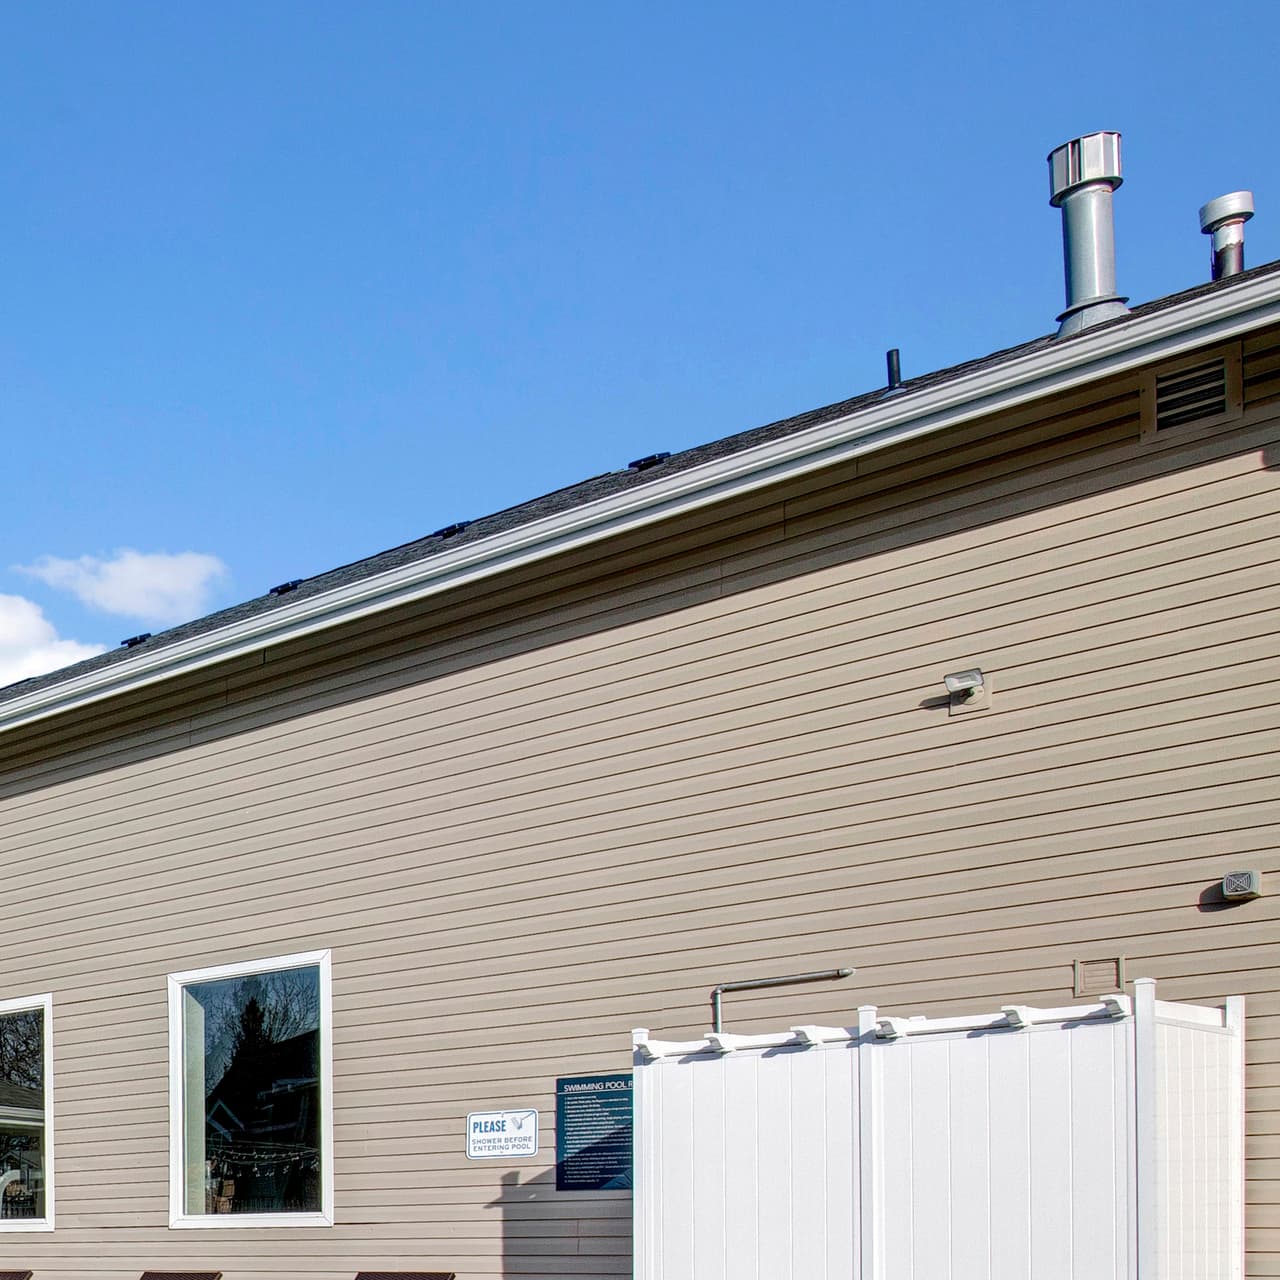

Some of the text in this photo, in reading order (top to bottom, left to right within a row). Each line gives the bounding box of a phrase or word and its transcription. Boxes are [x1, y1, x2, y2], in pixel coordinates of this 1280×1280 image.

[564, 1083, 604, 1092] SWIMMING
[605, 1081, 627, 1089] POOL
[473, 1120, 507, 1133] PLEASE
[472, 1137, 503, 1145] SHOWER
[473, 1144, 510, 1152] ENTERING
